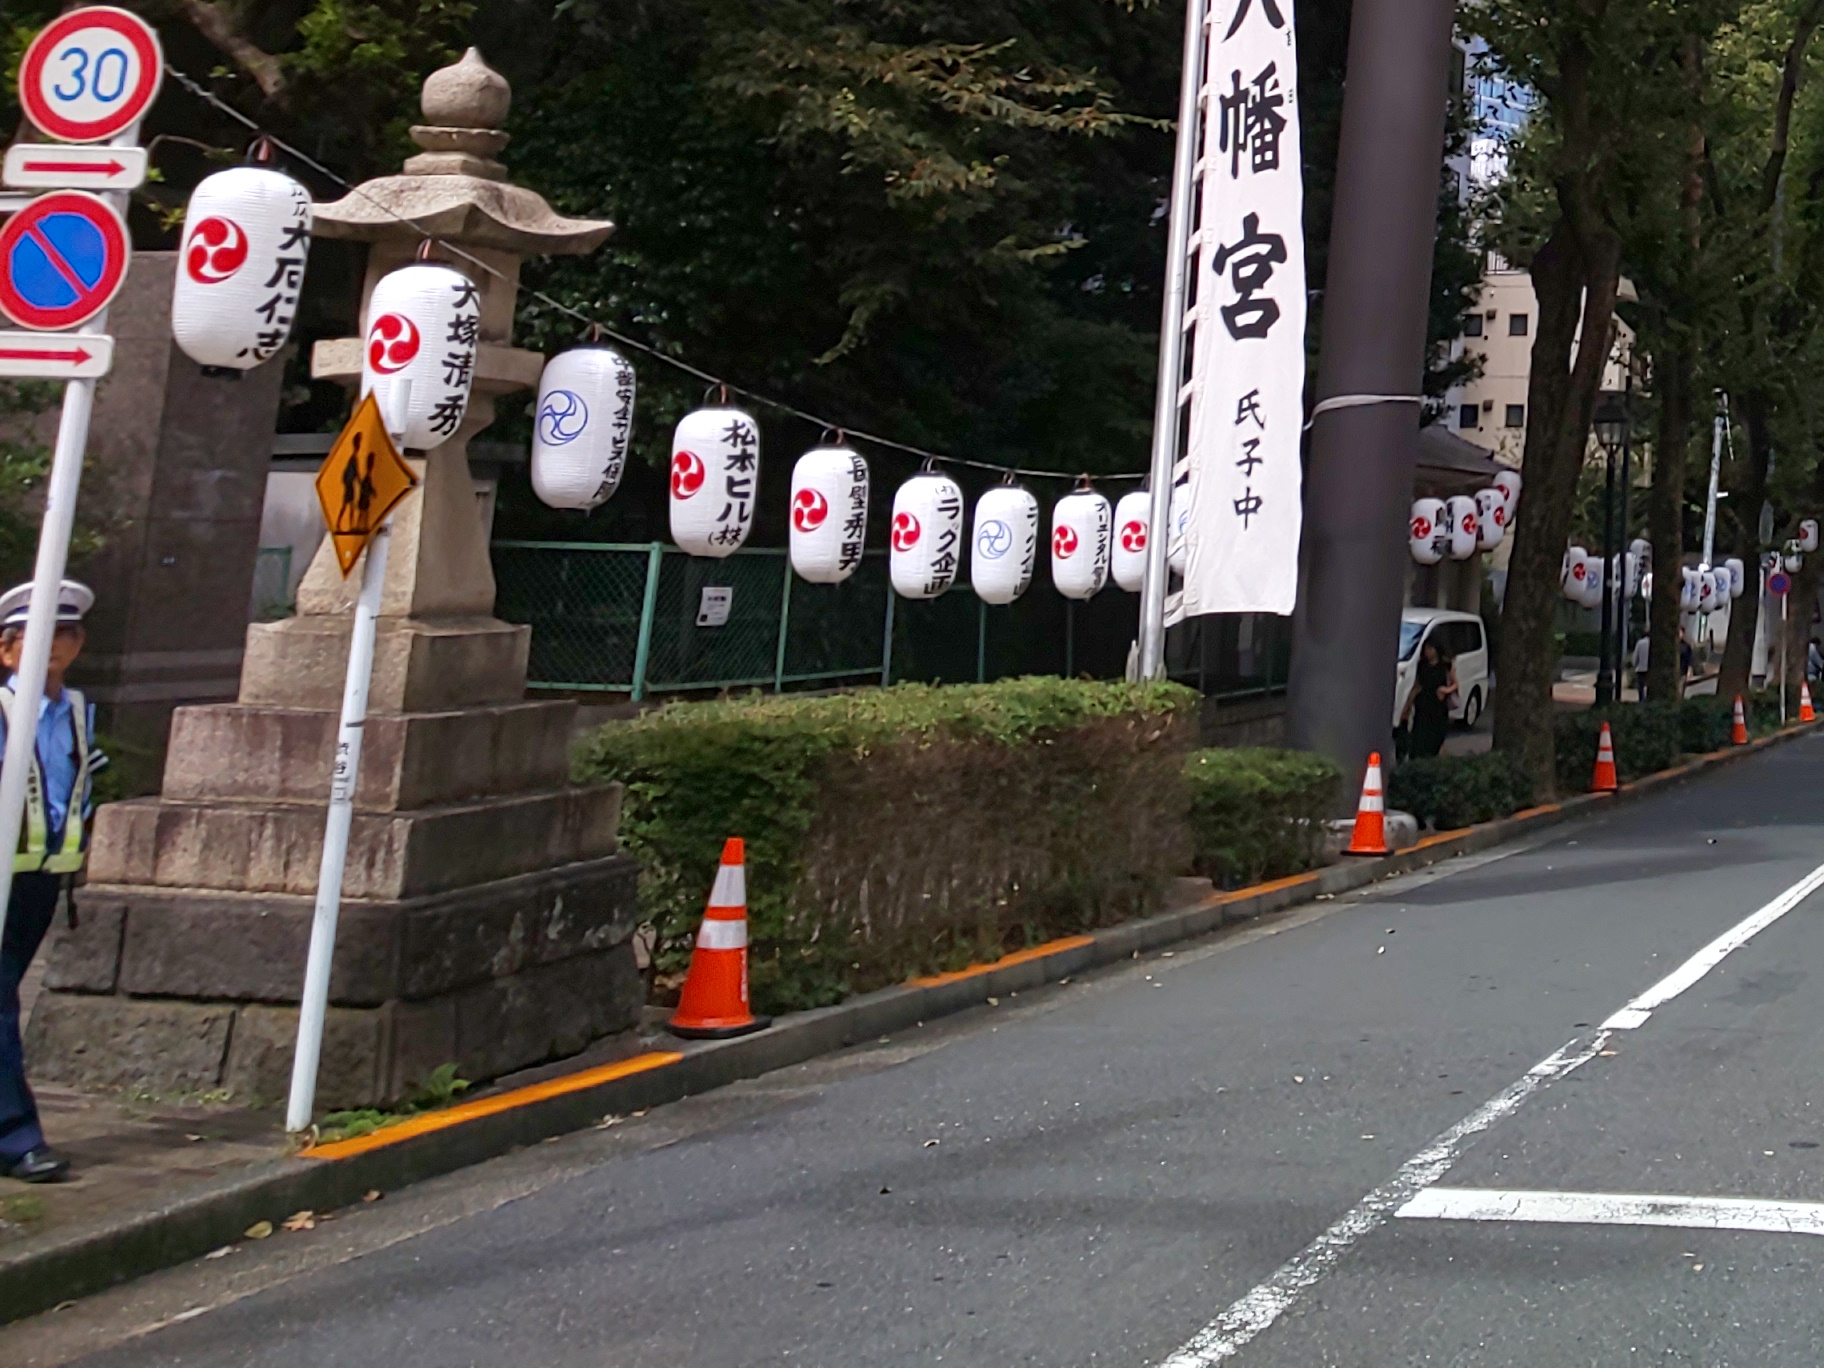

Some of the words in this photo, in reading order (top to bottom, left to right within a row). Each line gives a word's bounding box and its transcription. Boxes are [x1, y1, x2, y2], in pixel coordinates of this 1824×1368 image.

[53, 47, 128, 102] 30
[1232, 388, 1267, 532] 氏子中
